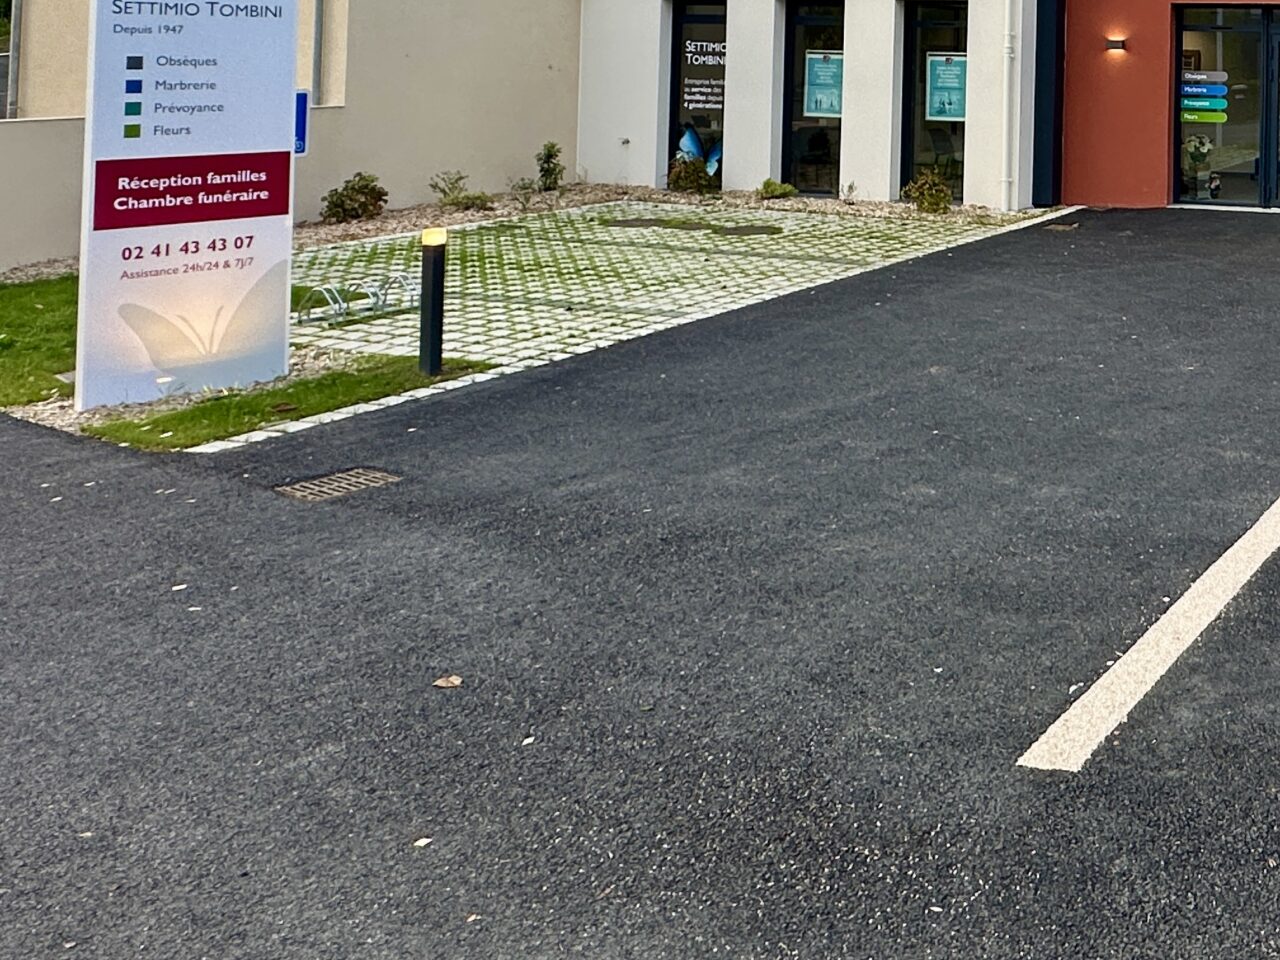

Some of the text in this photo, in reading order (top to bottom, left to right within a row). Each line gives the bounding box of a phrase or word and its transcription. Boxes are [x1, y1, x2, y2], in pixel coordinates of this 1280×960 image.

[205, 1, 283, 18] TOMBINI
[113, 23, 184, 37] Depuis 1947
[155, 80, 217, 91] Marbrerie
[154, 102, 224, 115] Prévoyance
[153, 125, 192, 136] Fleurs
[117, 170, 267, 191] Réception familles
[113, 189, 270, 210] Chambre funéraire
[121, 235, 254, 261] 02 41 43 43 07
[120, 266, 179, 280] Assistance
[222, 259, 231, 269] &
